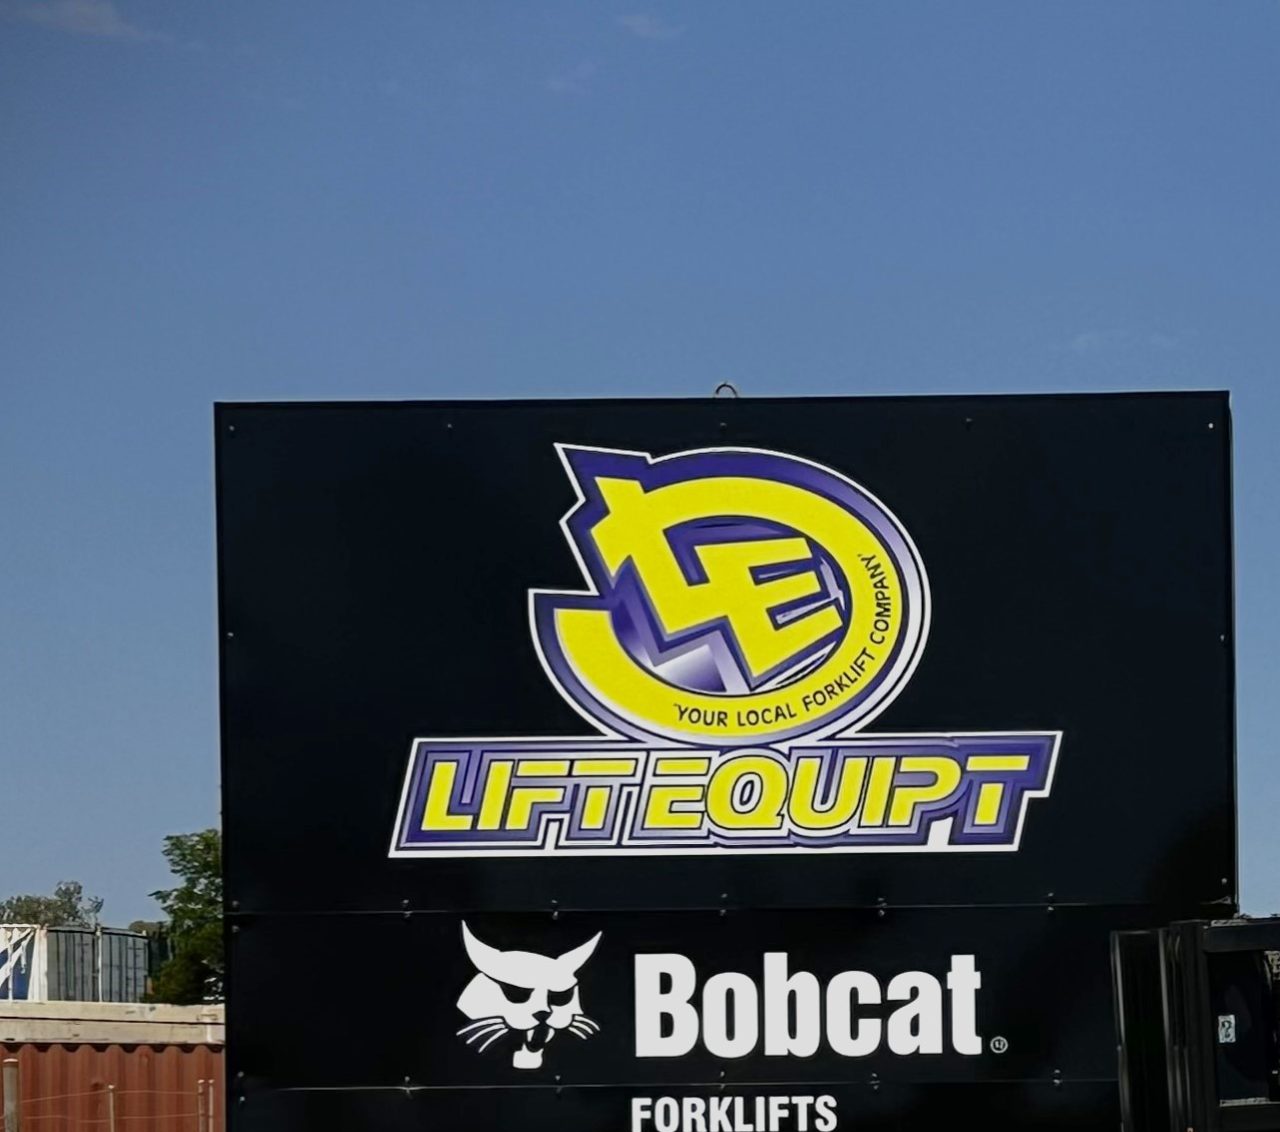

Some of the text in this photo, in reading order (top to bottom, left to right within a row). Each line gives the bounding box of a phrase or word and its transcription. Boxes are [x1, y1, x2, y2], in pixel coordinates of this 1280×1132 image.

[737, 703, 797, 727] LOCAL
[802, 647, 876, 713] FORKLIFT
[634, 952, 983, 1059] Bobcat
